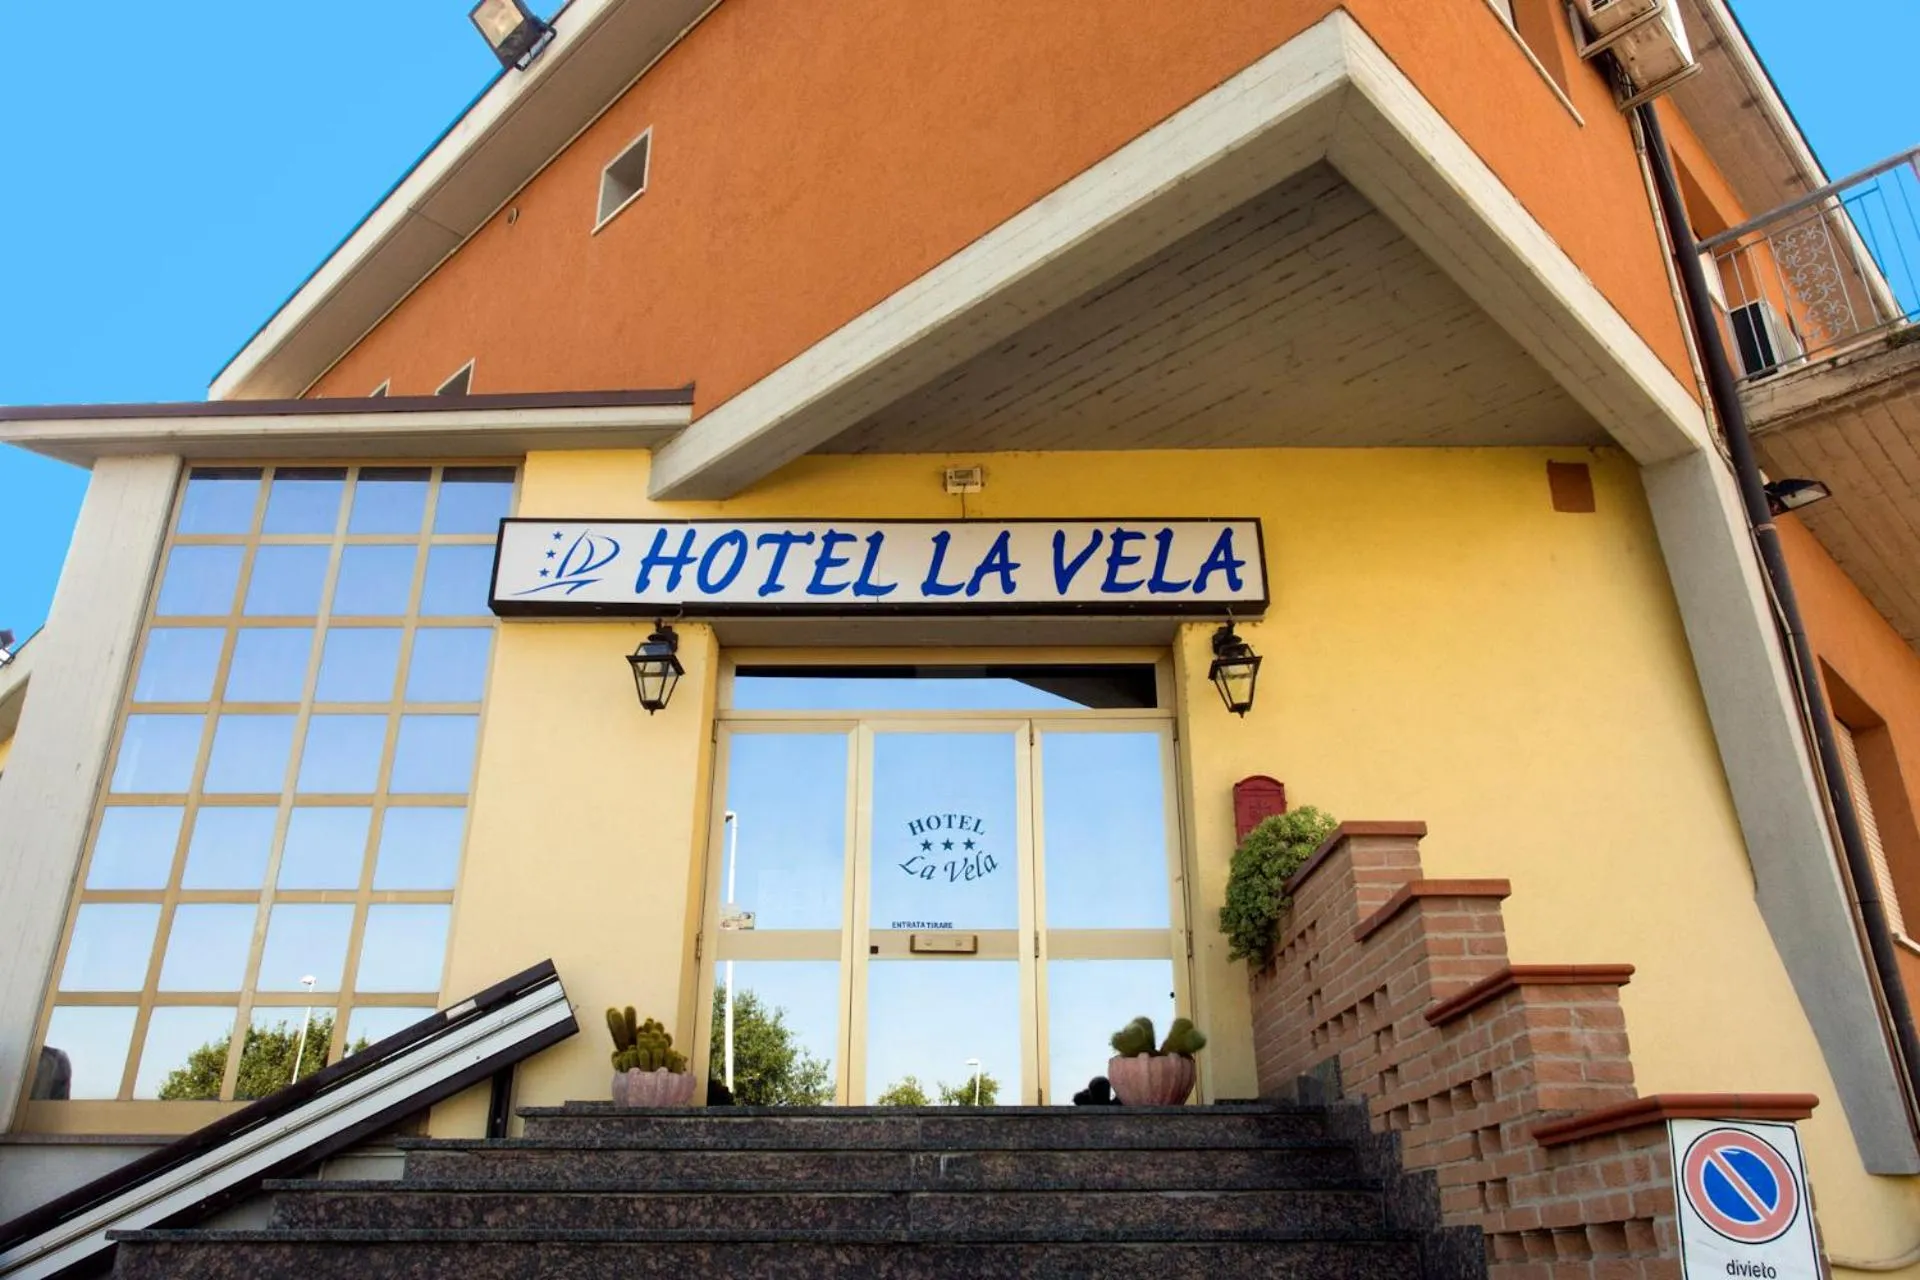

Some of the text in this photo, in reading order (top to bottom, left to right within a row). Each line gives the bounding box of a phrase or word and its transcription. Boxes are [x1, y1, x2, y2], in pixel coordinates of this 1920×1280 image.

[635, 527, 1246, 597] HOTEL LA VELA
[907, 813, 986, 837] HOTEL
[898, 850, 999, 883] La Vela
[891, 920, 953, 929] ENTRATA TIRARE
[1725, 1259, 1777, 1280] divieto
